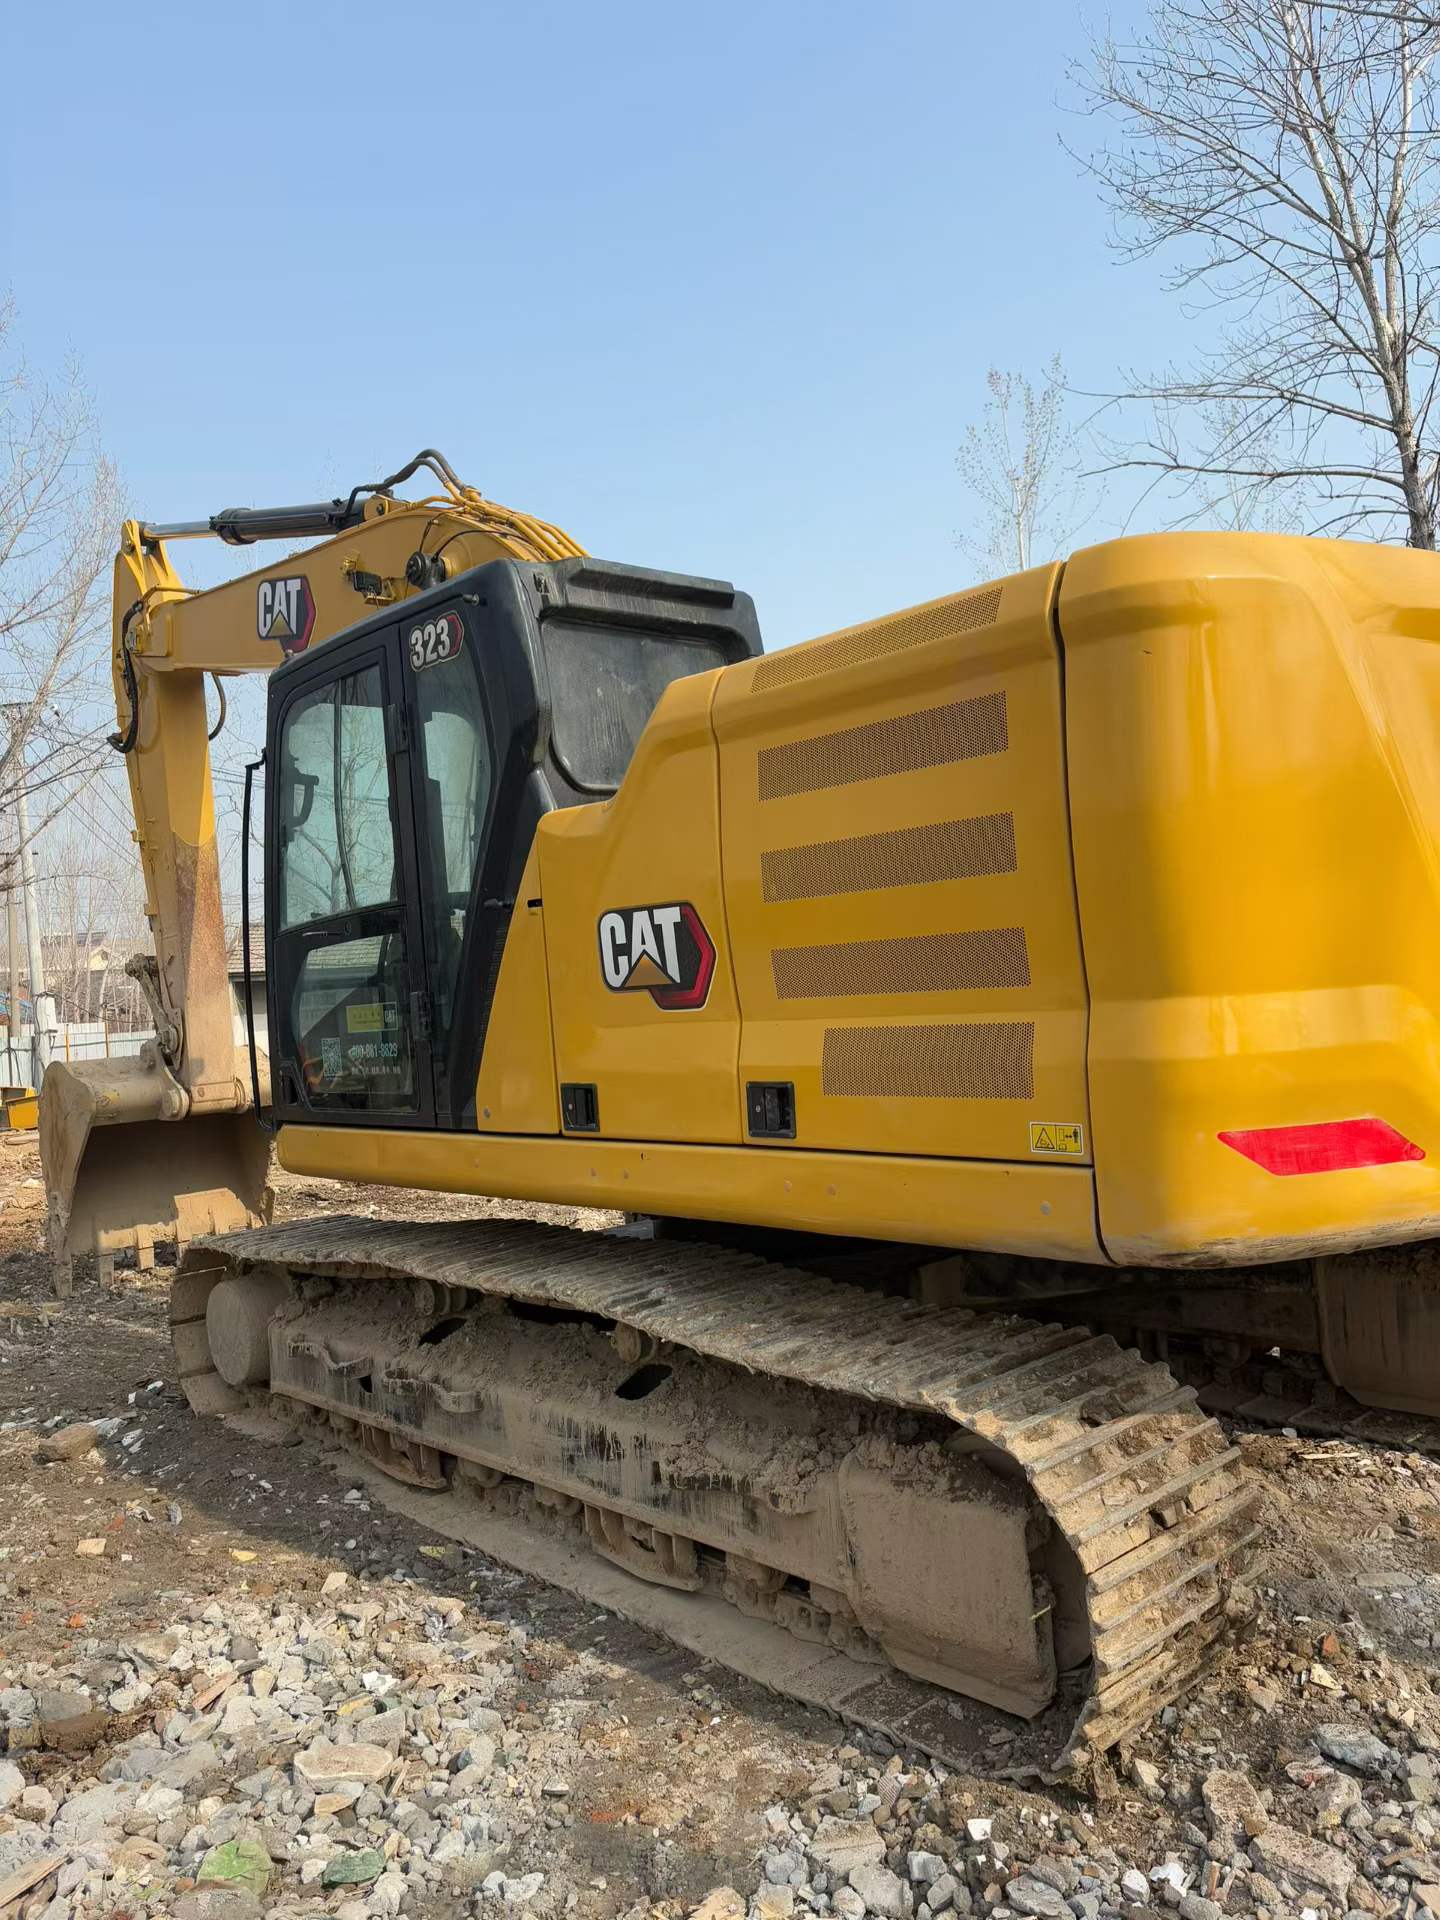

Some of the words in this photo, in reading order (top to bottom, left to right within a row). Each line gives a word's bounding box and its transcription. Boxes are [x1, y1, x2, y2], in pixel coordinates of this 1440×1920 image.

[258, 578, 302, 637] CAT
[410, 617, 451, 668] 323
[599, 906, 681, 988] CAT
